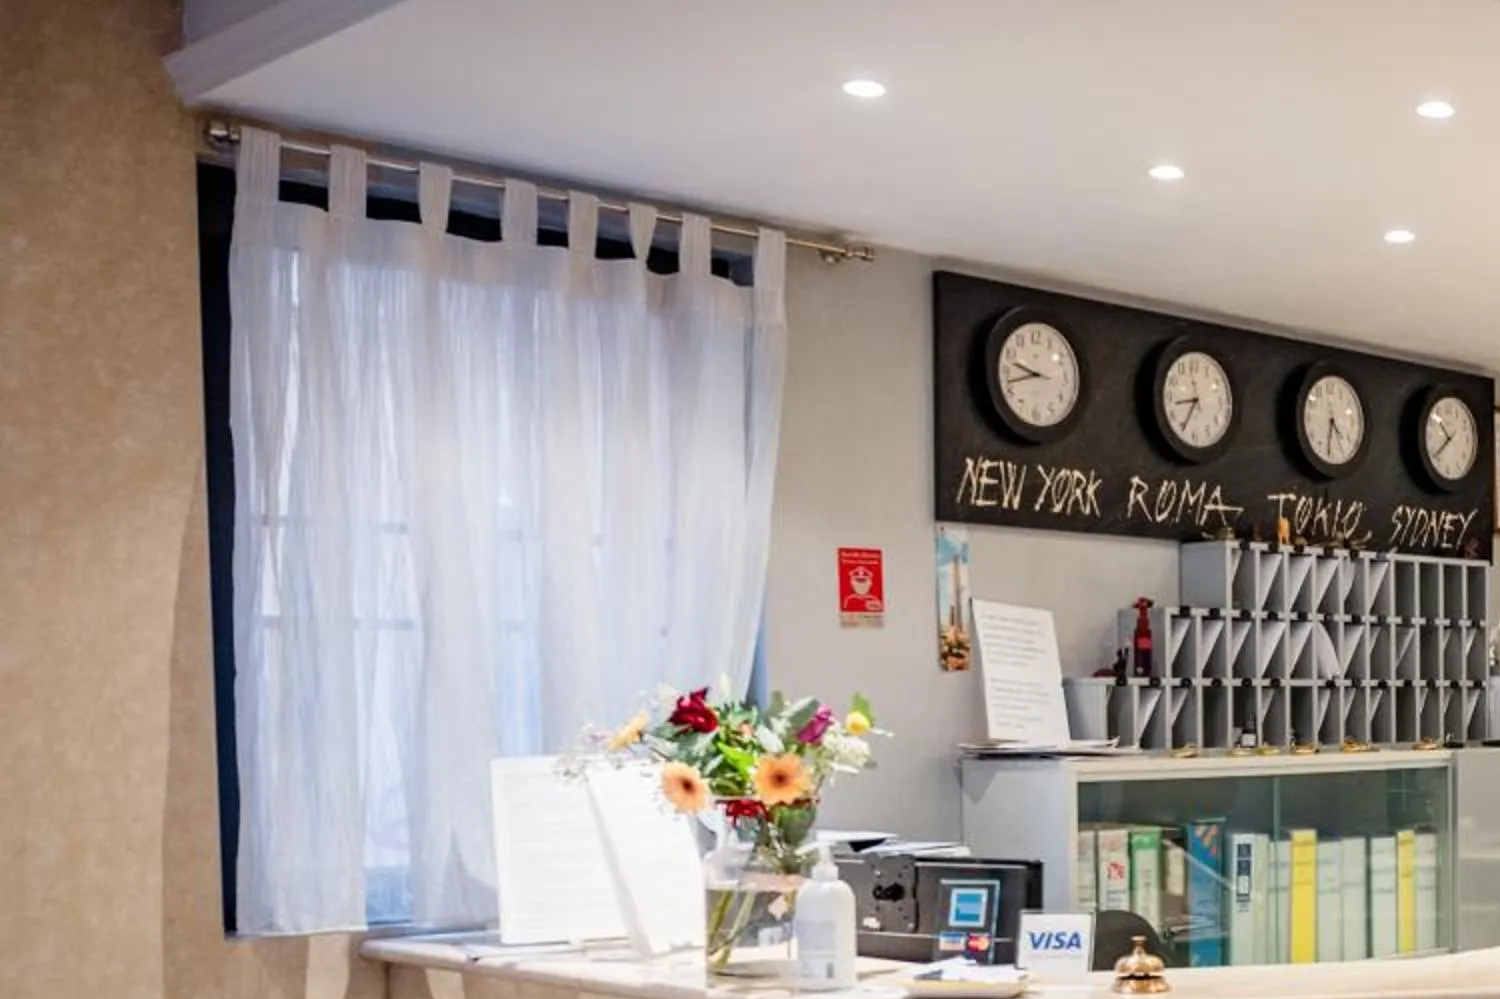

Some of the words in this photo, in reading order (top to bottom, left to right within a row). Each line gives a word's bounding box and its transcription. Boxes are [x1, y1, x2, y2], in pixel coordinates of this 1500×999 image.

[956, 455, 1028, 511] NEW
[1033, 464, 1103, 518] YORK
[1127, 474, 1243, 527] ROMA
[1267, 493, 1367, 538] TOKIO
[1388, 504, 1479, 549] SYDNEY
[1029, 932, 1083, 950] VISA
